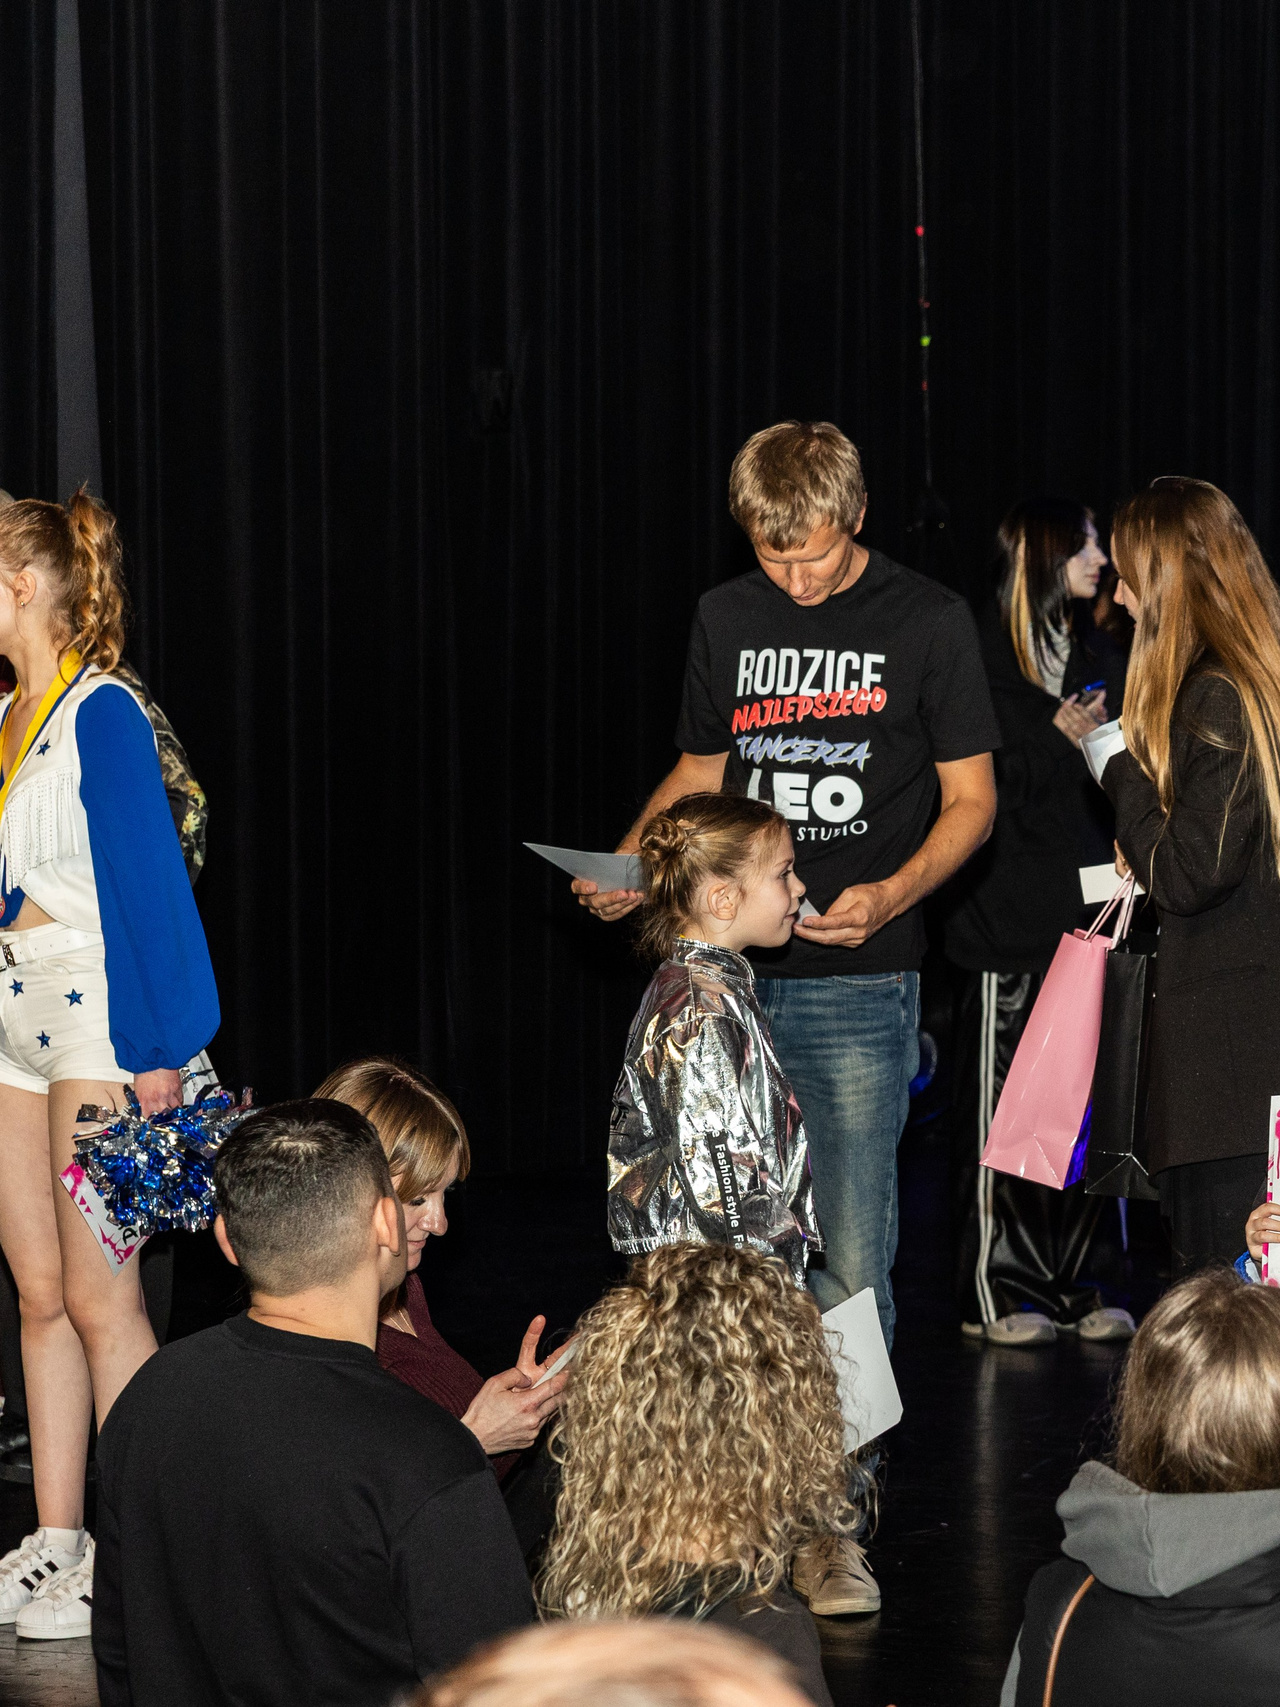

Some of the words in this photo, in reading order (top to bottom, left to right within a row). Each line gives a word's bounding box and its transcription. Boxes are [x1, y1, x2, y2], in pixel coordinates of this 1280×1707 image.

[736, 648, 886, 702] RODZICE
[731, 686, 888, 734] NAJLEPSZEGO
[736, 732, 873, 773] TANCERZA
[747, 768, 864, 823] LEO
[714, 1143, 733, 1194] Fashion
[725, 1195, 741, 1228] style
